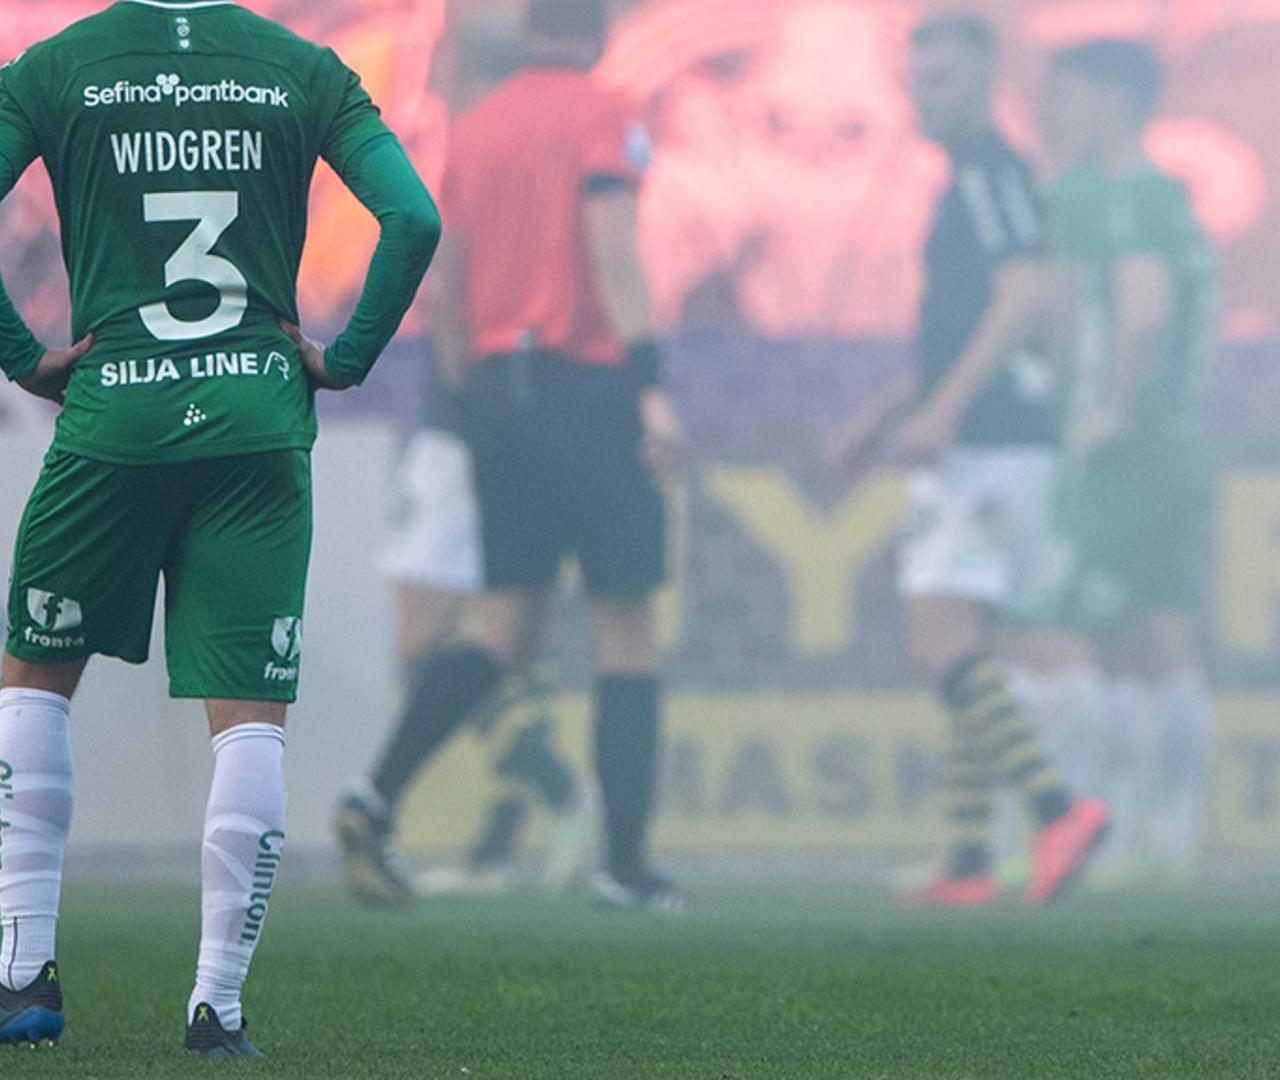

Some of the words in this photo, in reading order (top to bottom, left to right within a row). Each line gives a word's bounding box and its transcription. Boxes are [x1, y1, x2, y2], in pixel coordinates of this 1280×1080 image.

[83, 80, 161, 107] Sefina
[175, 79, 289, 108] pantbank
[110, 129, 263, 174] WIDGREN
[139, 191, 249, 341] 3
[100, 358, 180, 387] SILJA
[190, 352, 258, 378] LINE
[240, 829, 285, 942] Clinton
